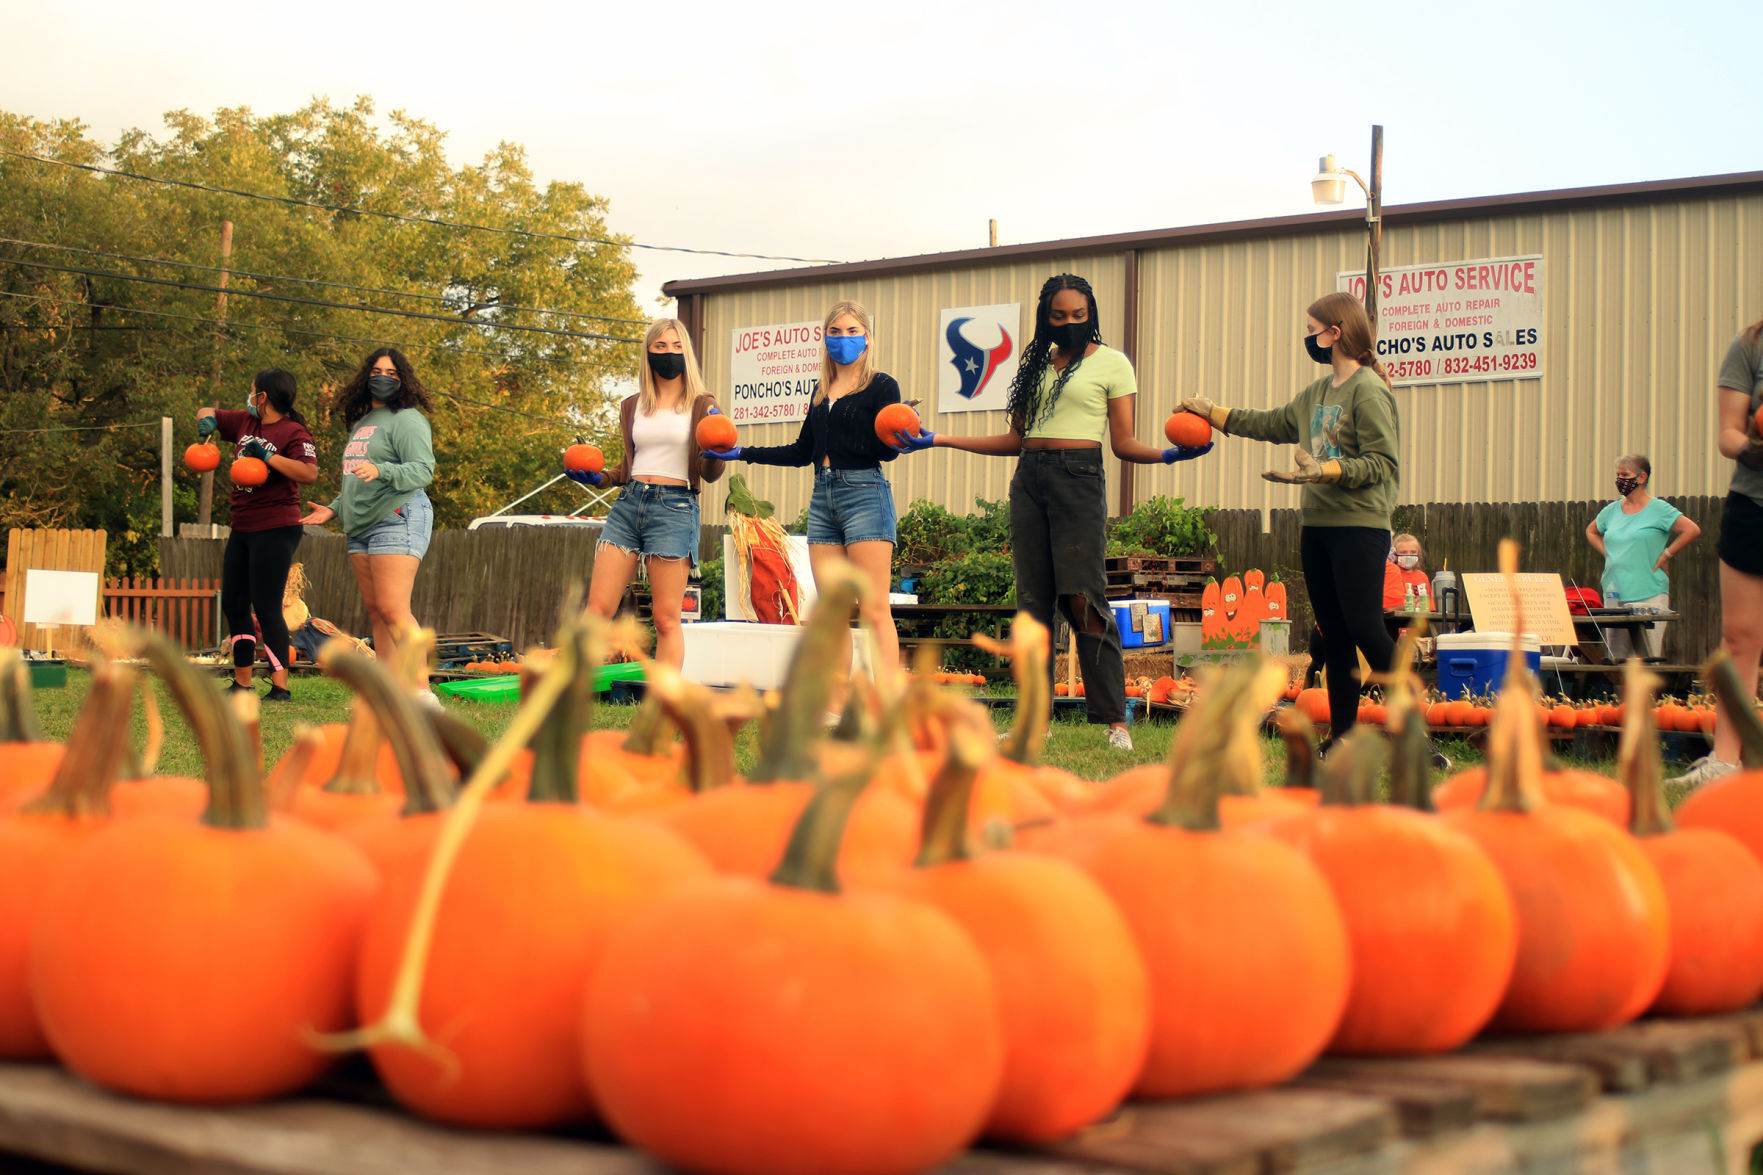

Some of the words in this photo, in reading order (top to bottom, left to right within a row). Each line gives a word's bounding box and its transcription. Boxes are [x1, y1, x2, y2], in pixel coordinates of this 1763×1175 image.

[1348, 274, 1393, 303] JO'S
[1399, 270, 1448, 296] AUTO
[1455, 262, 1536, 294] SERVICE
[1382, 303, 1431, 318] COMPLETE
[1435, 301, 1462, 314] AUTO
[1466, 298, 1501, 311] REPAIR
[1389, 319, 1429, 332] FOREIGN
[1433, 318, 1440, 330] &
[1445, 315, 1493, 330] DOMESTIC
[736, 330, 771, 354] JOE'S
[773, 327, 810, 346] AUTO
[1376, 336, 1427, 356] CHO'S
[1432, 332, 1478, 352] AUTO
[756, 349, 796, 362] COMPLETE
[797, 348, 817, 359] AUTO
[1435, 358, 1441, 376] /
[1444, 352, 1537, 375] 832-451-9239
[761, 364, 794, 376] FOREIGN
[795, 364, 801, 374] &
[735, 381, 792, 400] PONCHO'S
[794, 378, 818, 396] AUT
[734, 403, 795, 420] 281-342-5780
[797, 403, 801, 416] /
